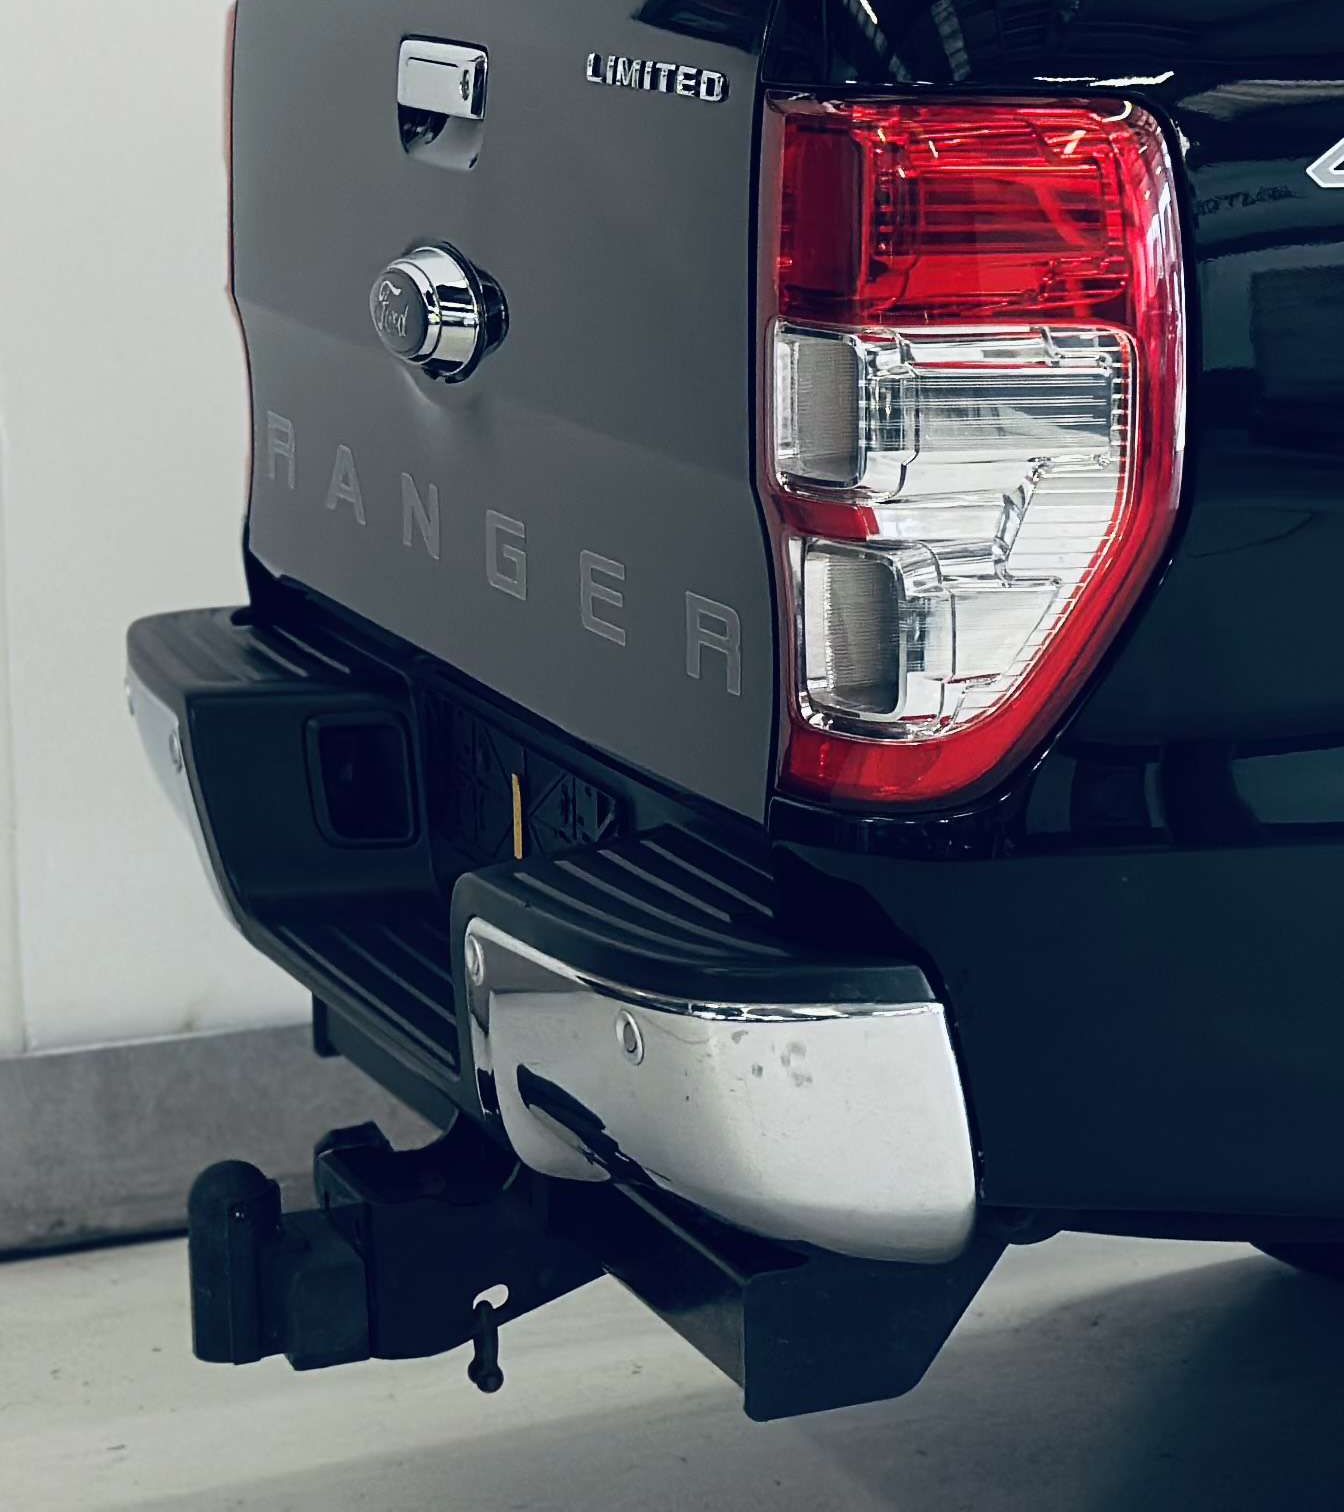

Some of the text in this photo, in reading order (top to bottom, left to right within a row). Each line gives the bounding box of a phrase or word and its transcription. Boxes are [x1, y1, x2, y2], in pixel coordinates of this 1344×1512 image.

[585, 51, 728, 103] LIMITED
[377, 279, 410, 338] Ford
[262, 408, 742, 697] RANGER
